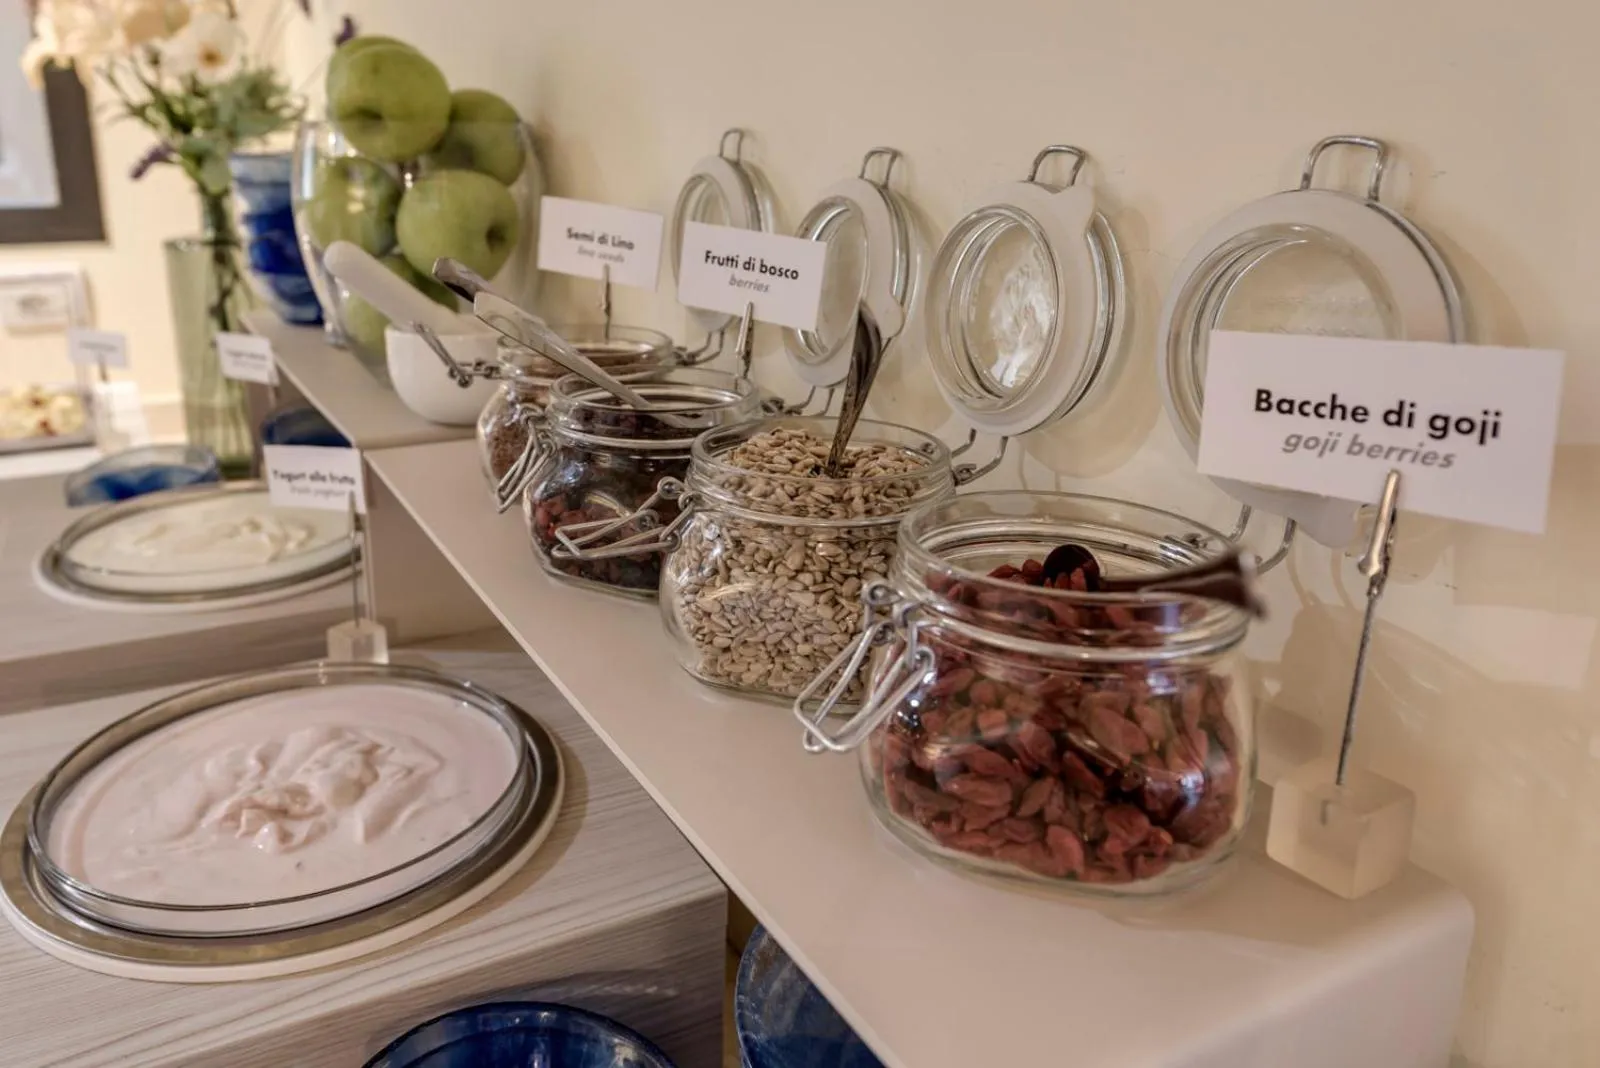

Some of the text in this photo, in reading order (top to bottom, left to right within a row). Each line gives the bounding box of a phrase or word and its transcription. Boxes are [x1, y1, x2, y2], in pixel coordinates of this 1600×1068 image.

[567, 226, 595, 242] Semi
[597, 232, 609, 246] di
[704, 249, 800, 280] Frutti di bosco
[728, 273, 771, 293] berries
[1254, 388, 1503, 446] Bacche di goji
[1281, 430, 1456, 469] goji berries
